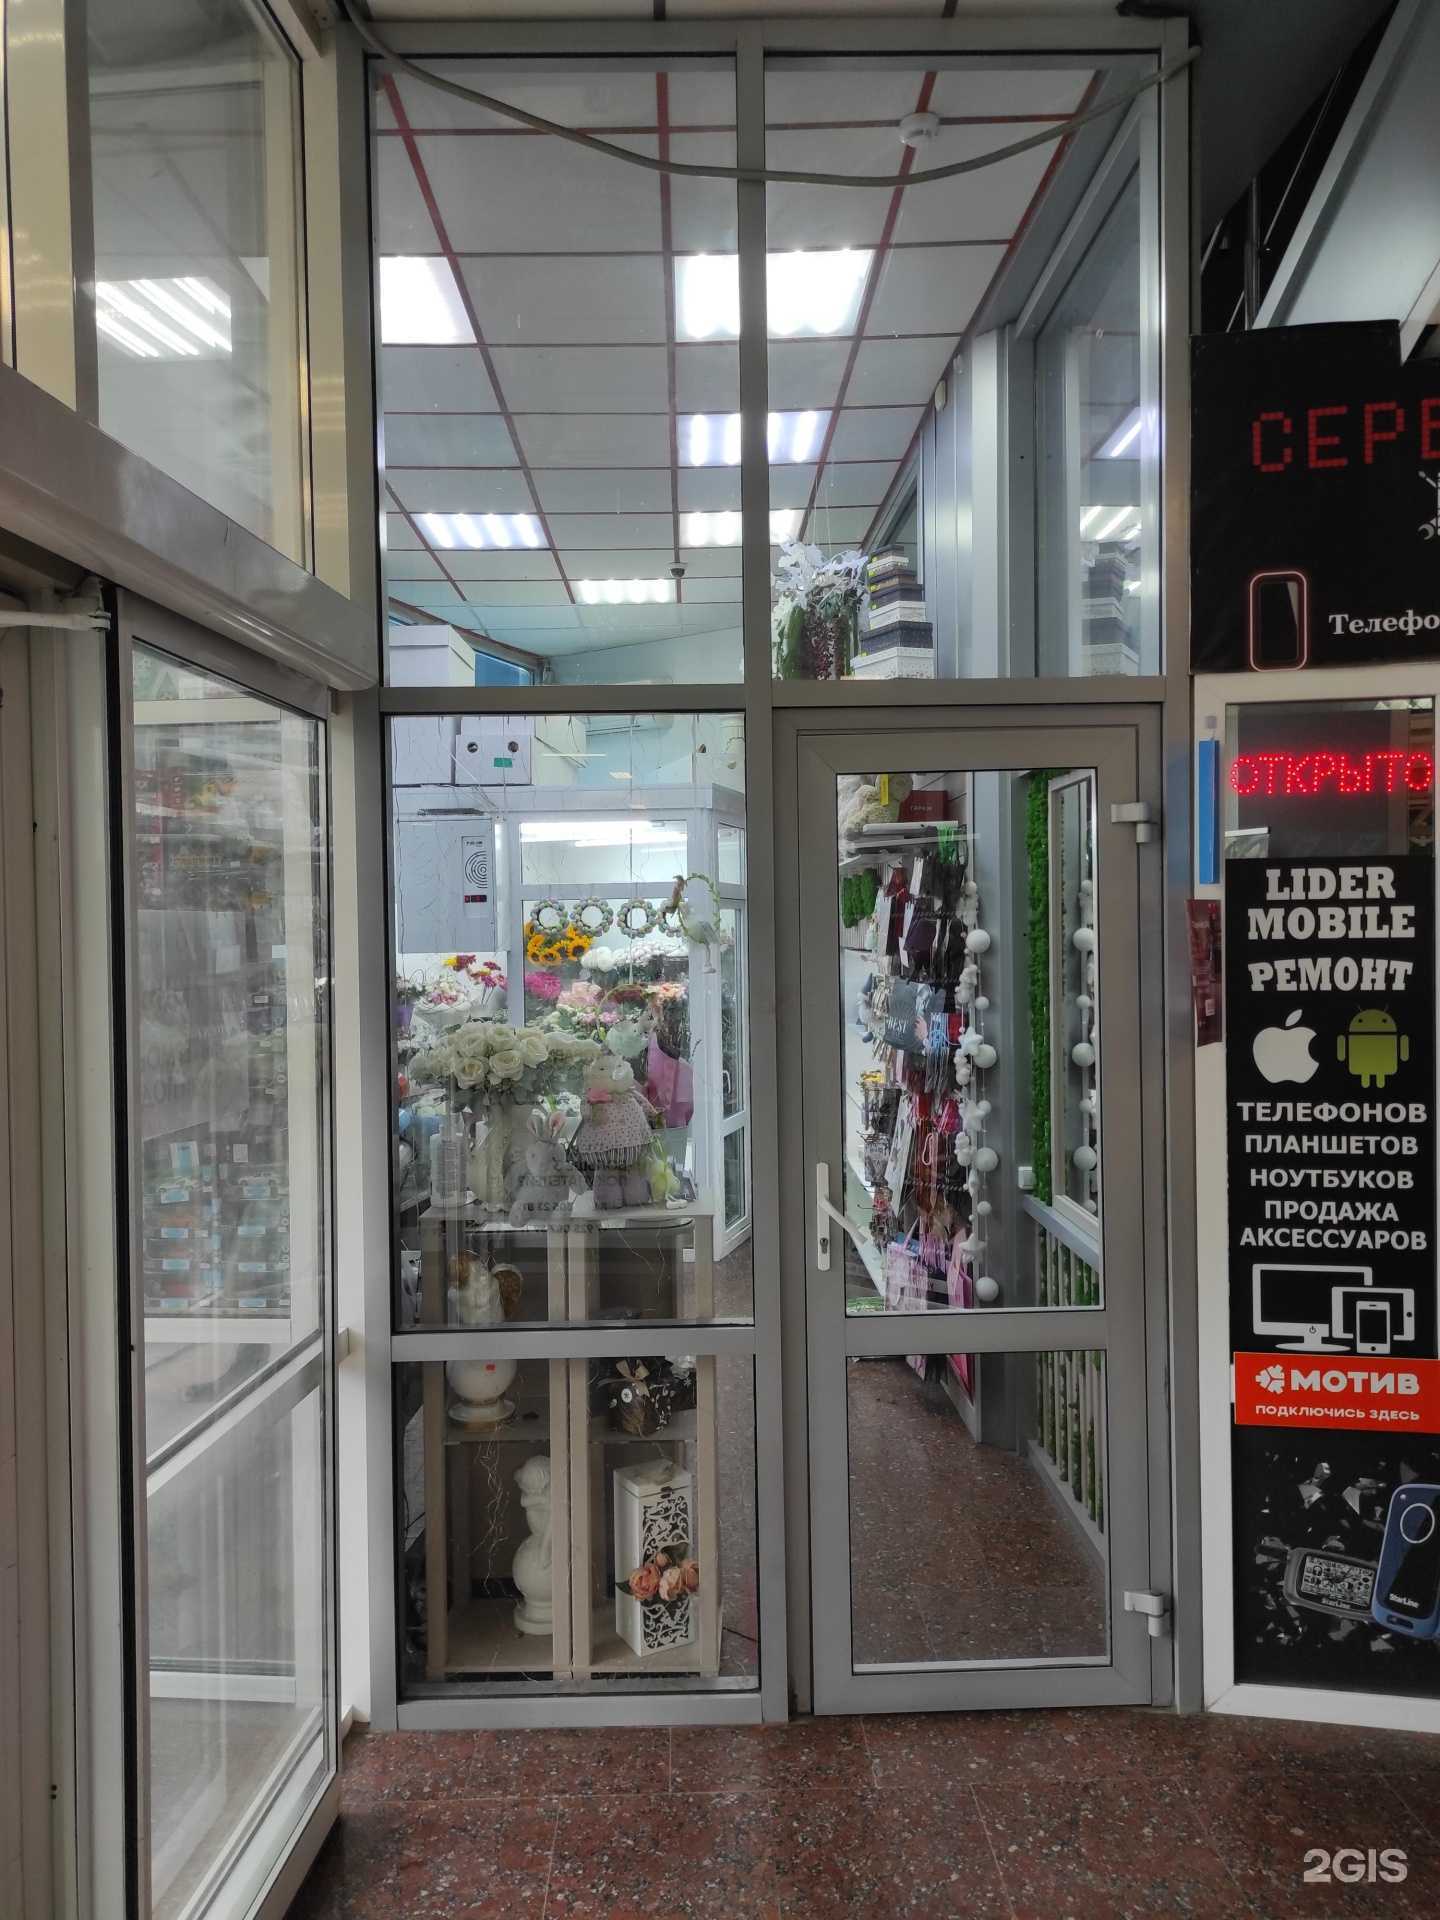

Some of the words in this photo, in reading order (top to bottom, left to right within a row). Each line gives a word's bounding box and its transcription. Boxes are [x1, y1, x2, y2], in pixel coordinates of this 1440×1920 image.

[1328, 609, 1440, 636] Телефо
[1229, 751, 1433, 796] ОТКРЫТО
[1266, 866, 1397, 900] LIDER
[1247, 905, 1416, 940] MOBILE
[1247, 957, 1414, 992] РЕМОНТ
[1236, 1102, 1428, 1123] ТЕЛЕФОНОВ
[1245, 1134, 1419, 1155] ПЛАНШЕТОВ
[1250, 1168, 1415, 1189] НОУТБУКОВ
[1264, 1201, 1399, 1224] ПРОДАЖА
[1239, 1227, 1428, 1250] АКСЕССУАРОВ
[1290, 1369, 1420, 1395] МОТИВ
